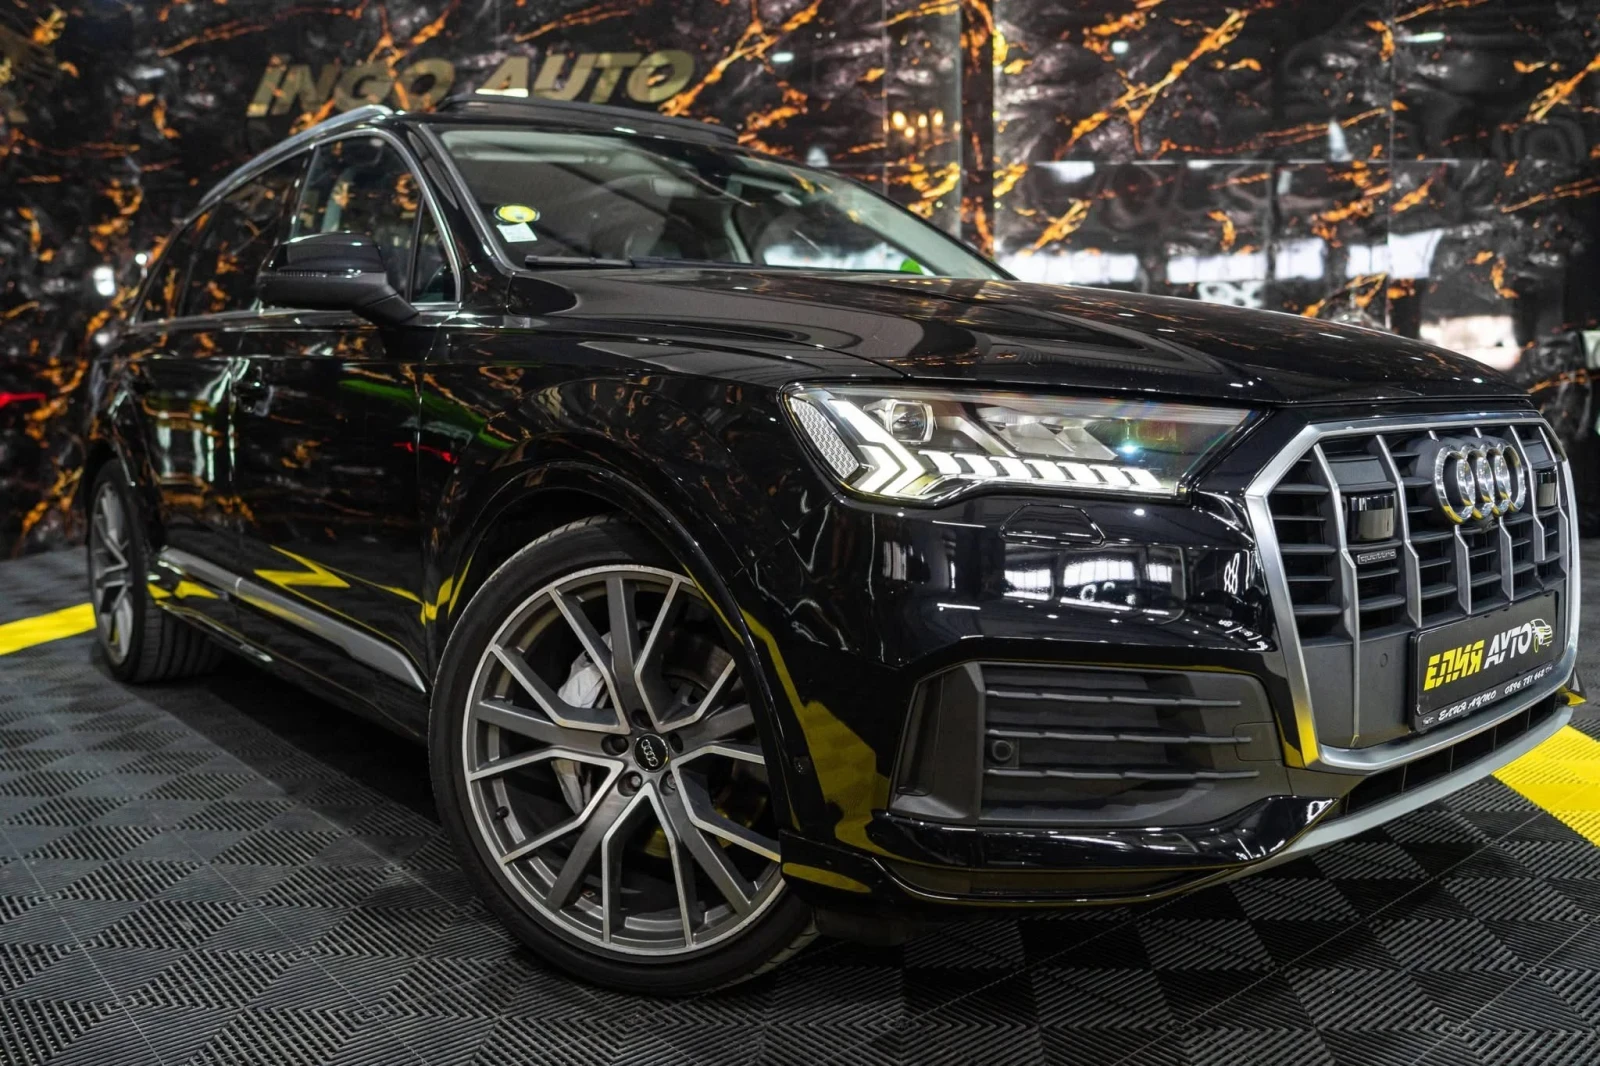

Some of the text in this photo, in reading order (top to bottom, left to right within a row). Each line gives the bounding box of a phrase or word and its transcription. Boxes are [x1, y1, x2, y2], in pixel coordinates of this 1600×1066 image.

[246, 49, 696, 117] INGO AUTO
[1359, 550, 1396, 563] quattro
[1423, 639, 1485, 692] ЕЛИЯ
